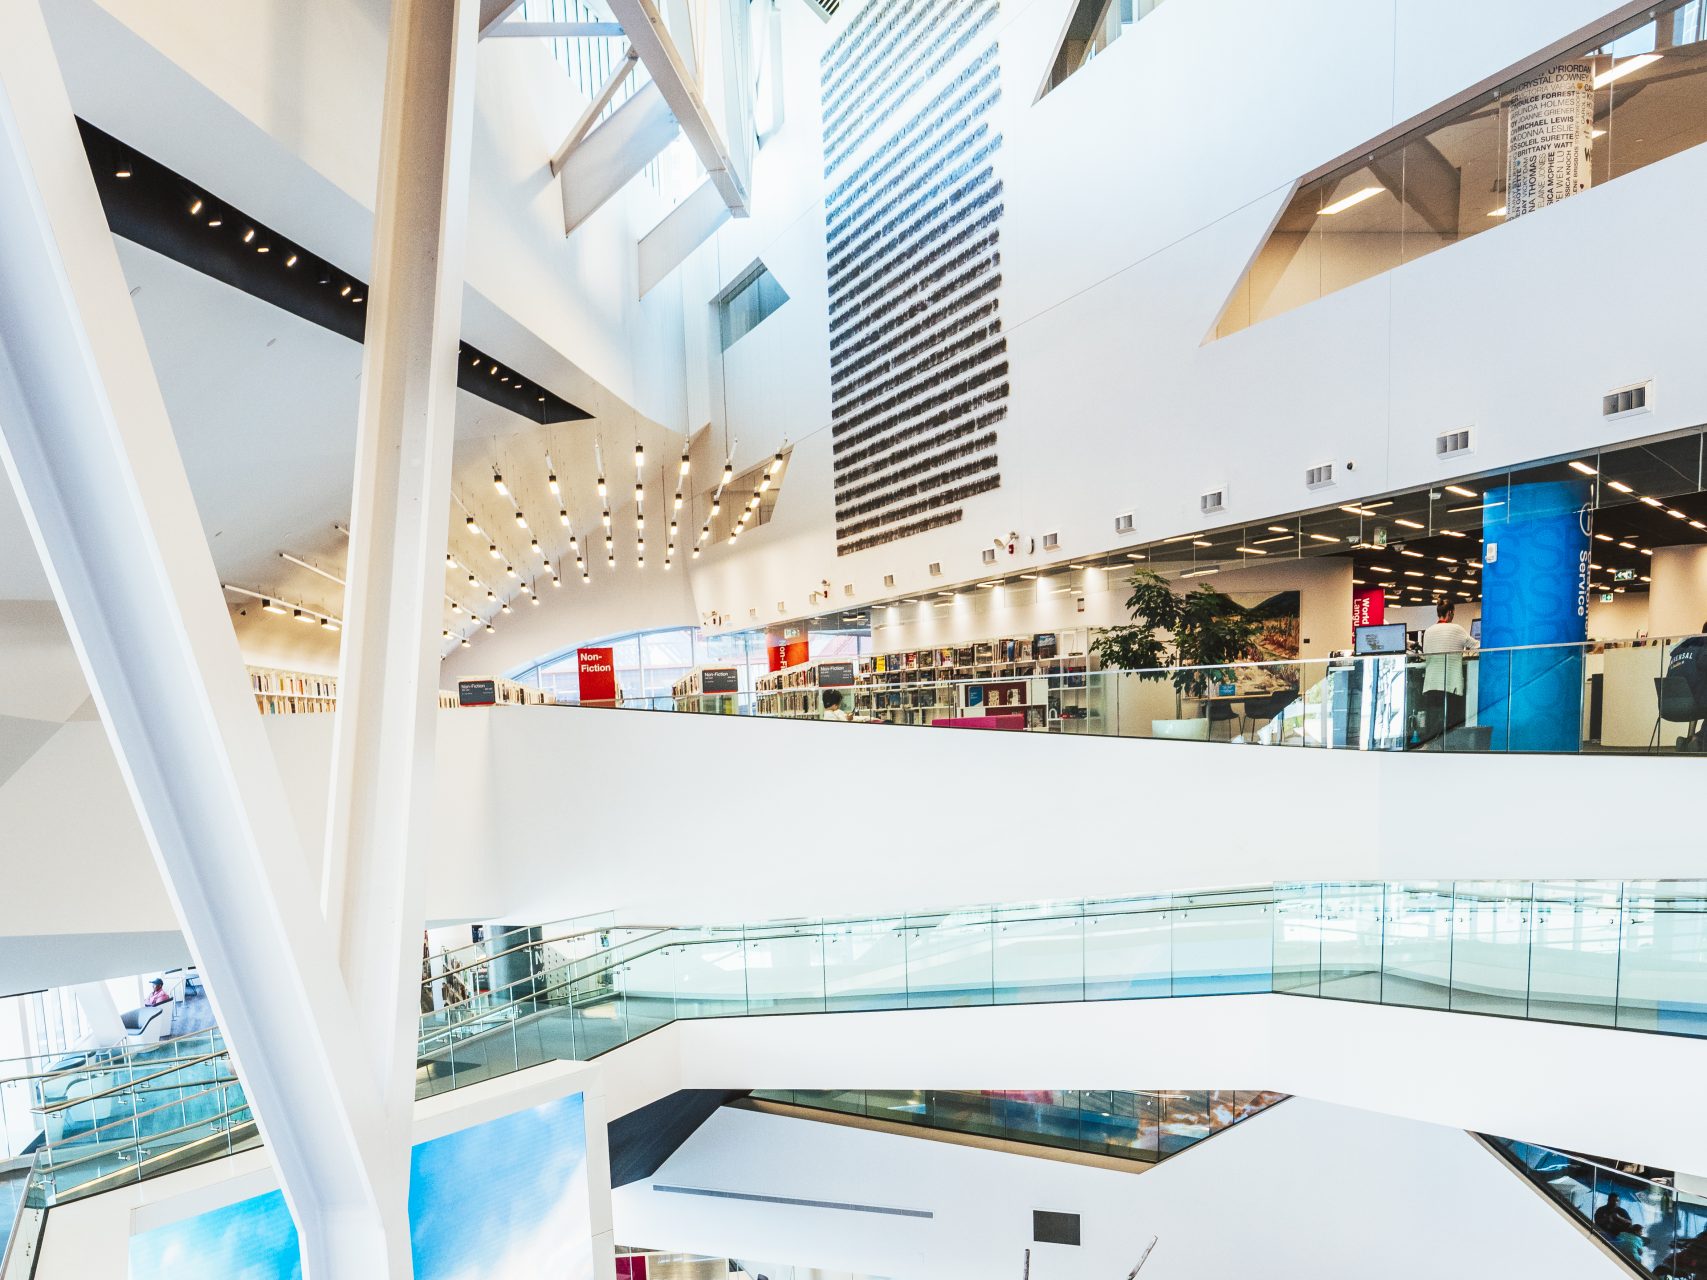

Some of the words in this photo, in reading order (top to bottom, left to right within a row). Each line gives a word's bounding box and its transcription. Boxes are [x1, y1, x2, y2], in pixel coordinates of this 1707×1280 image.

[1519, 75, 1554, 91] CRYSTAL
[1555, 73, 1589, 83] DOWNEY
[1540, 99, 1575, 109] HOLMES
[1541, 90, 1576, 101] FORREST
[1517, 119, 1548, 132] MICHAEL
[1550, 115, 1575, 126] LEWIS
[1517, 127, 1544, 141] DONNA
[1546, 124, 1574, 134] LESLIE
[1540, 133, 1574, 143] SURETTE
[1517, 143, 1552, 158] BRITTANY
[1553, 141, 1574, 149] WATT
[1556, 150, 1565, 165] LU
[1538, 152, 1547, 179] JONES
[1547, 151, 1556, 187] MCPHEE
[1528, 154, 1538, 198] THOMAS
[1556, 166, 1565, 189] WEN
[1577, 550, 1588, 617] Service
[1352, 598, 1362, 627] Langu
[1361, 597, 1370, 625] World
[580, 653, 603, 662] Non-
[580, 663, 612, 673] Fiction
